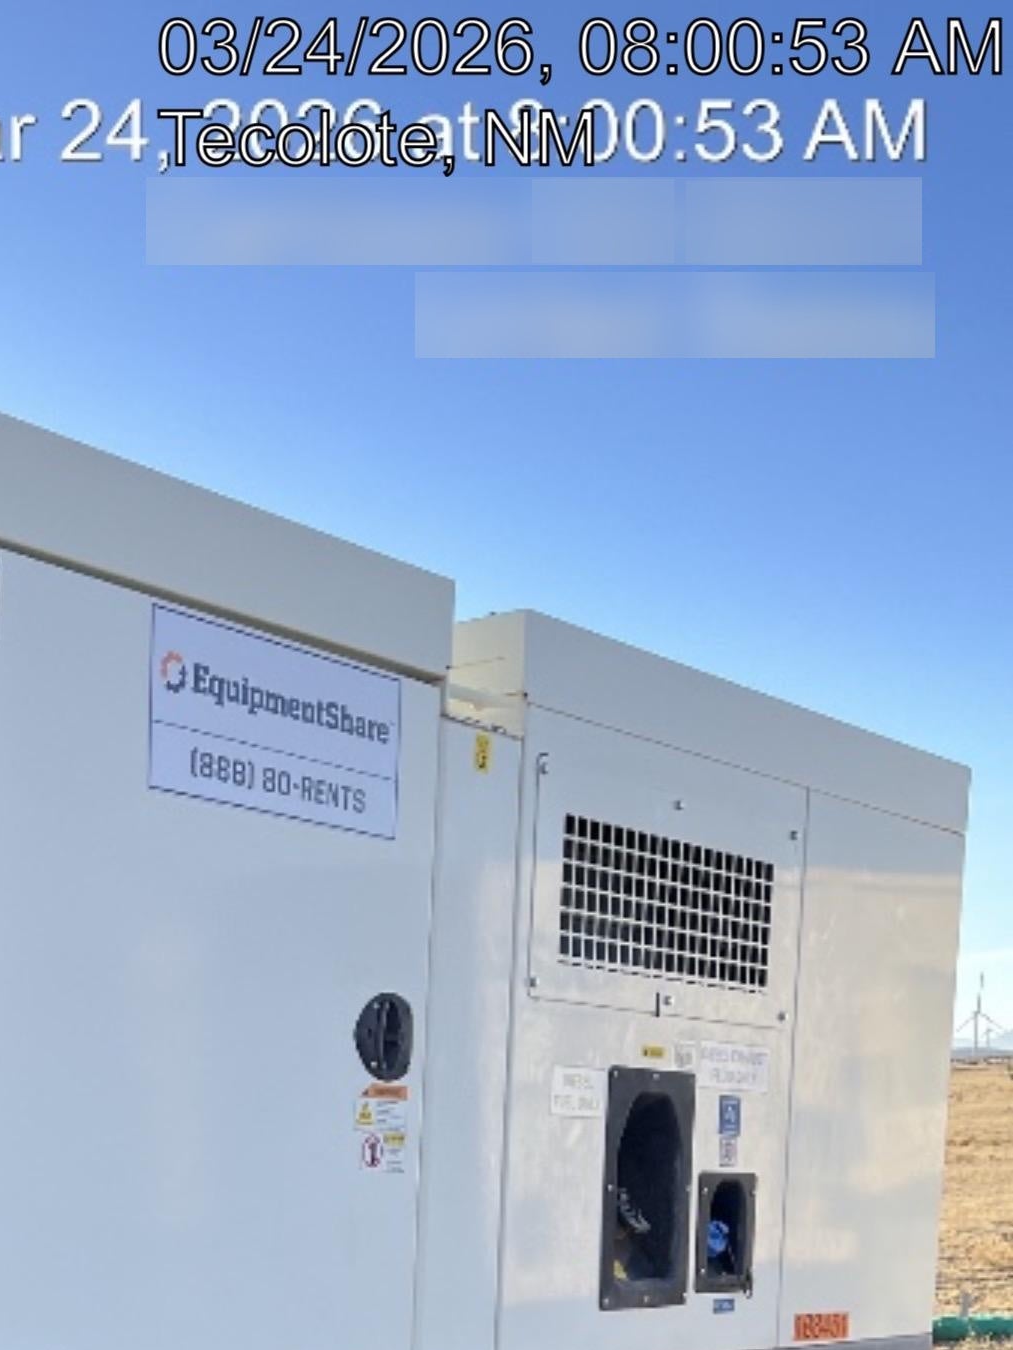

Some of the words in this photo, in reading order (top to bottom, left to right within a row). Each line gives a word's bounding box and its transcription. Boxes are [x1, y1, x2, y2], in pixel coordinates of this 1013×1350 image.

[192, 661, 390, 745] EquipmentShare
[190, 746, 255, 790] (888)
[262, 766, 367, 814] 80-RENTS
